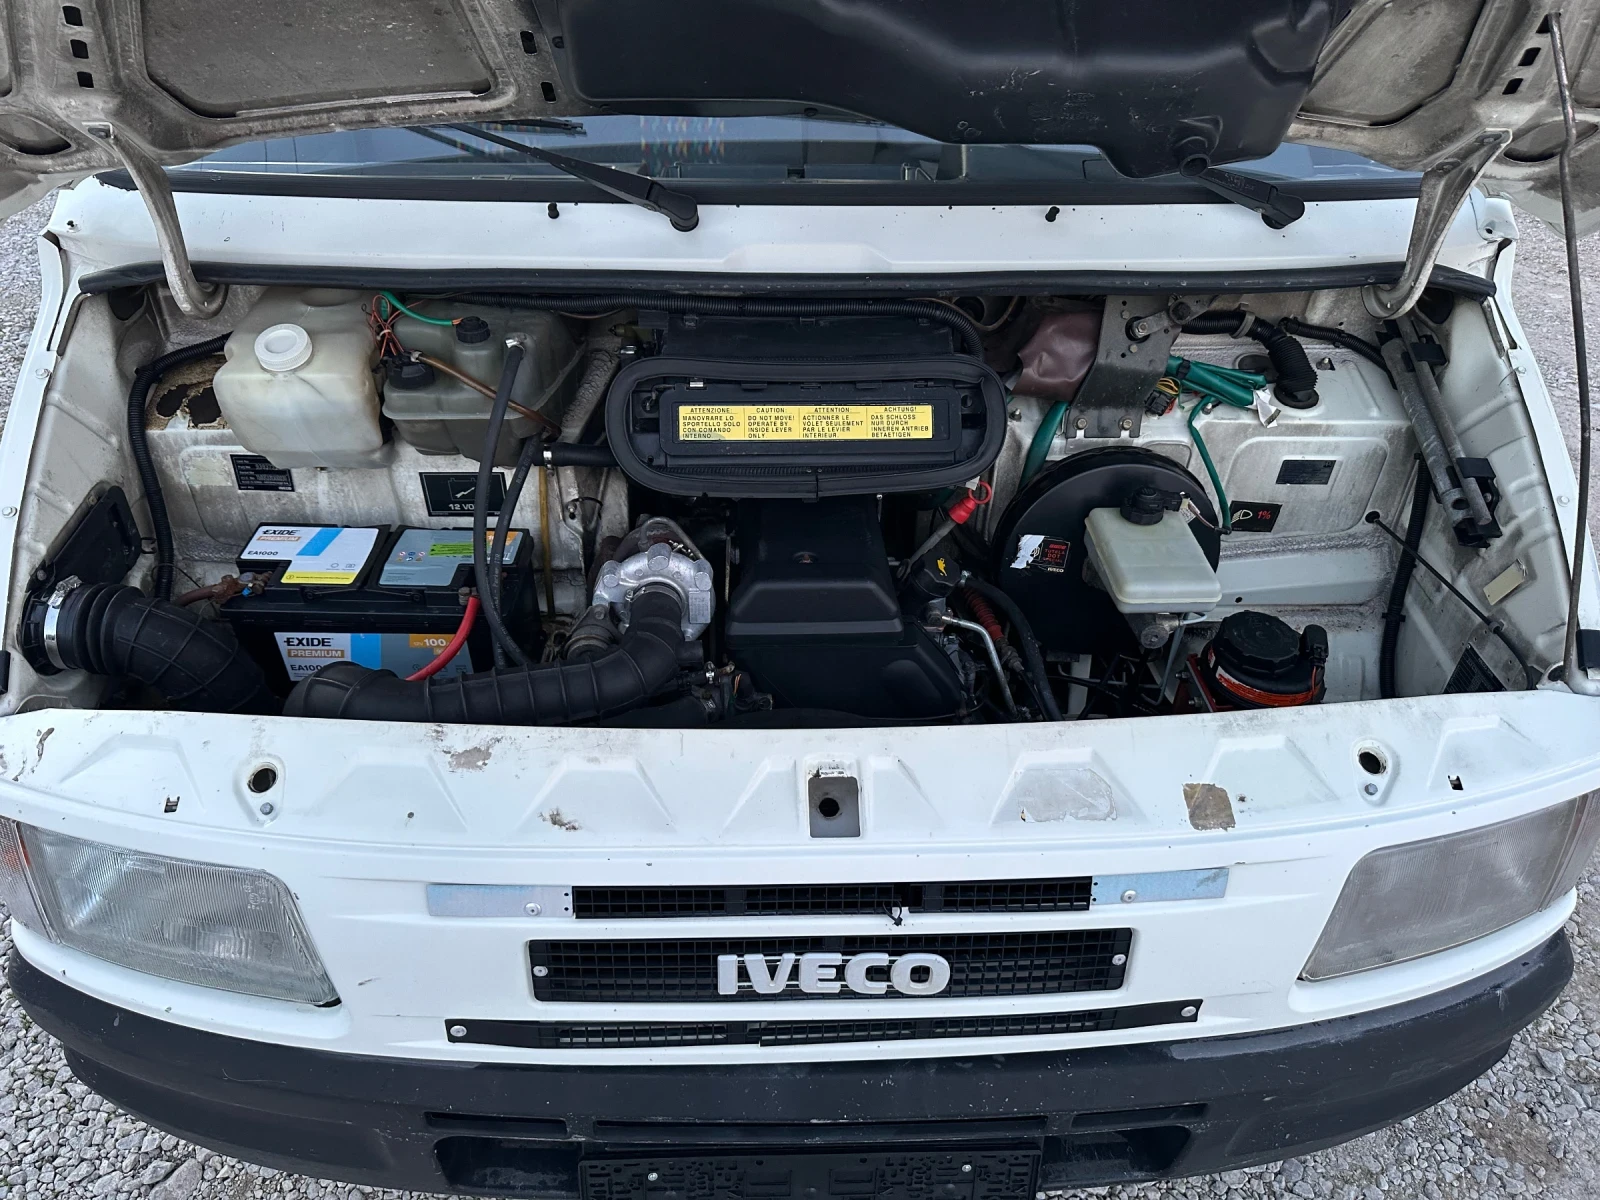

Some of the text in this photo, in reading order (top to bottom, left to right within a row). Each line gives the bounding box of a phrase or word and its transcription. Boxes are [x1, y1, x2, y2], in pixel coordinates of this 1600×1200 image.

[1257, 511, 1271, 519] 1%
[284, 638, 332, 647] EXIDE
[423, 638, 447, 647] 100
[290, 664, 322, 672] EA100
[718, 952, 950, 995] IVECO
